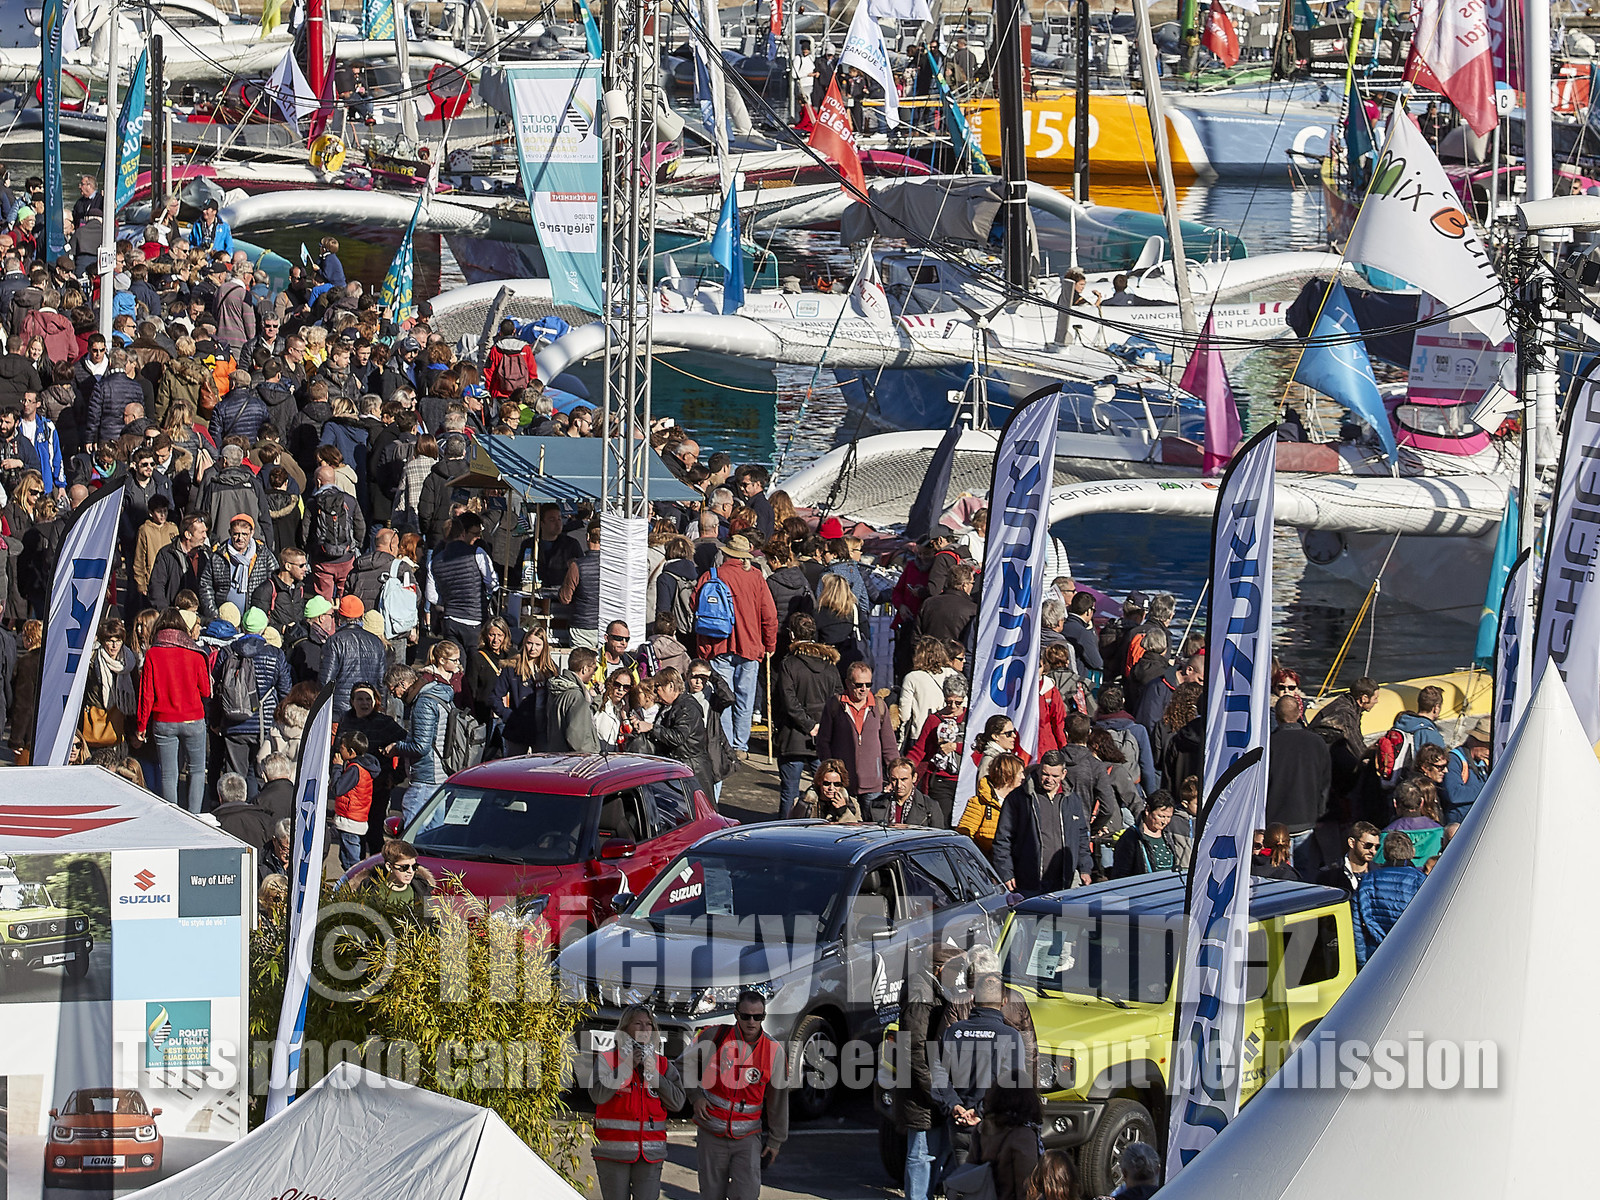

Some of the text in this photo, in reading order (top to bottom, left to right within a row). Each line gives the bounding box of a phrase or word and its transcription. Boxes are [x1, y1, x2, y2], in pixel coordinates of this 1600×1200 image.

[1501, 95, 1508, 109] C
[1193, 308, 1251, 319] NSEMBLE
[1217, 316, 1285, 330] EN PLAQUE
[989, 439, 1043, 711] SUZUKI
[190, 875, 207, 887] Way
[208, 874, 216, 885] of
[668, 882, 702, 904] SUZUKI
[119, 894, 171, 905] SUZUKI
[190, 918, 205, 928] style
[205, 918, 213, 927] de
[179, 1029, 209, 1038] ROUTE
[963, 1030, 996, 1039] SUZUKI
[169, 1036, 209, 1046] DU RHUM
[163, 1046, 209, 1055] DESTINATION
[163, 1053, 209, 1062] GUADELOUPE
[91, 1155, 117, 1165] IGNIS
